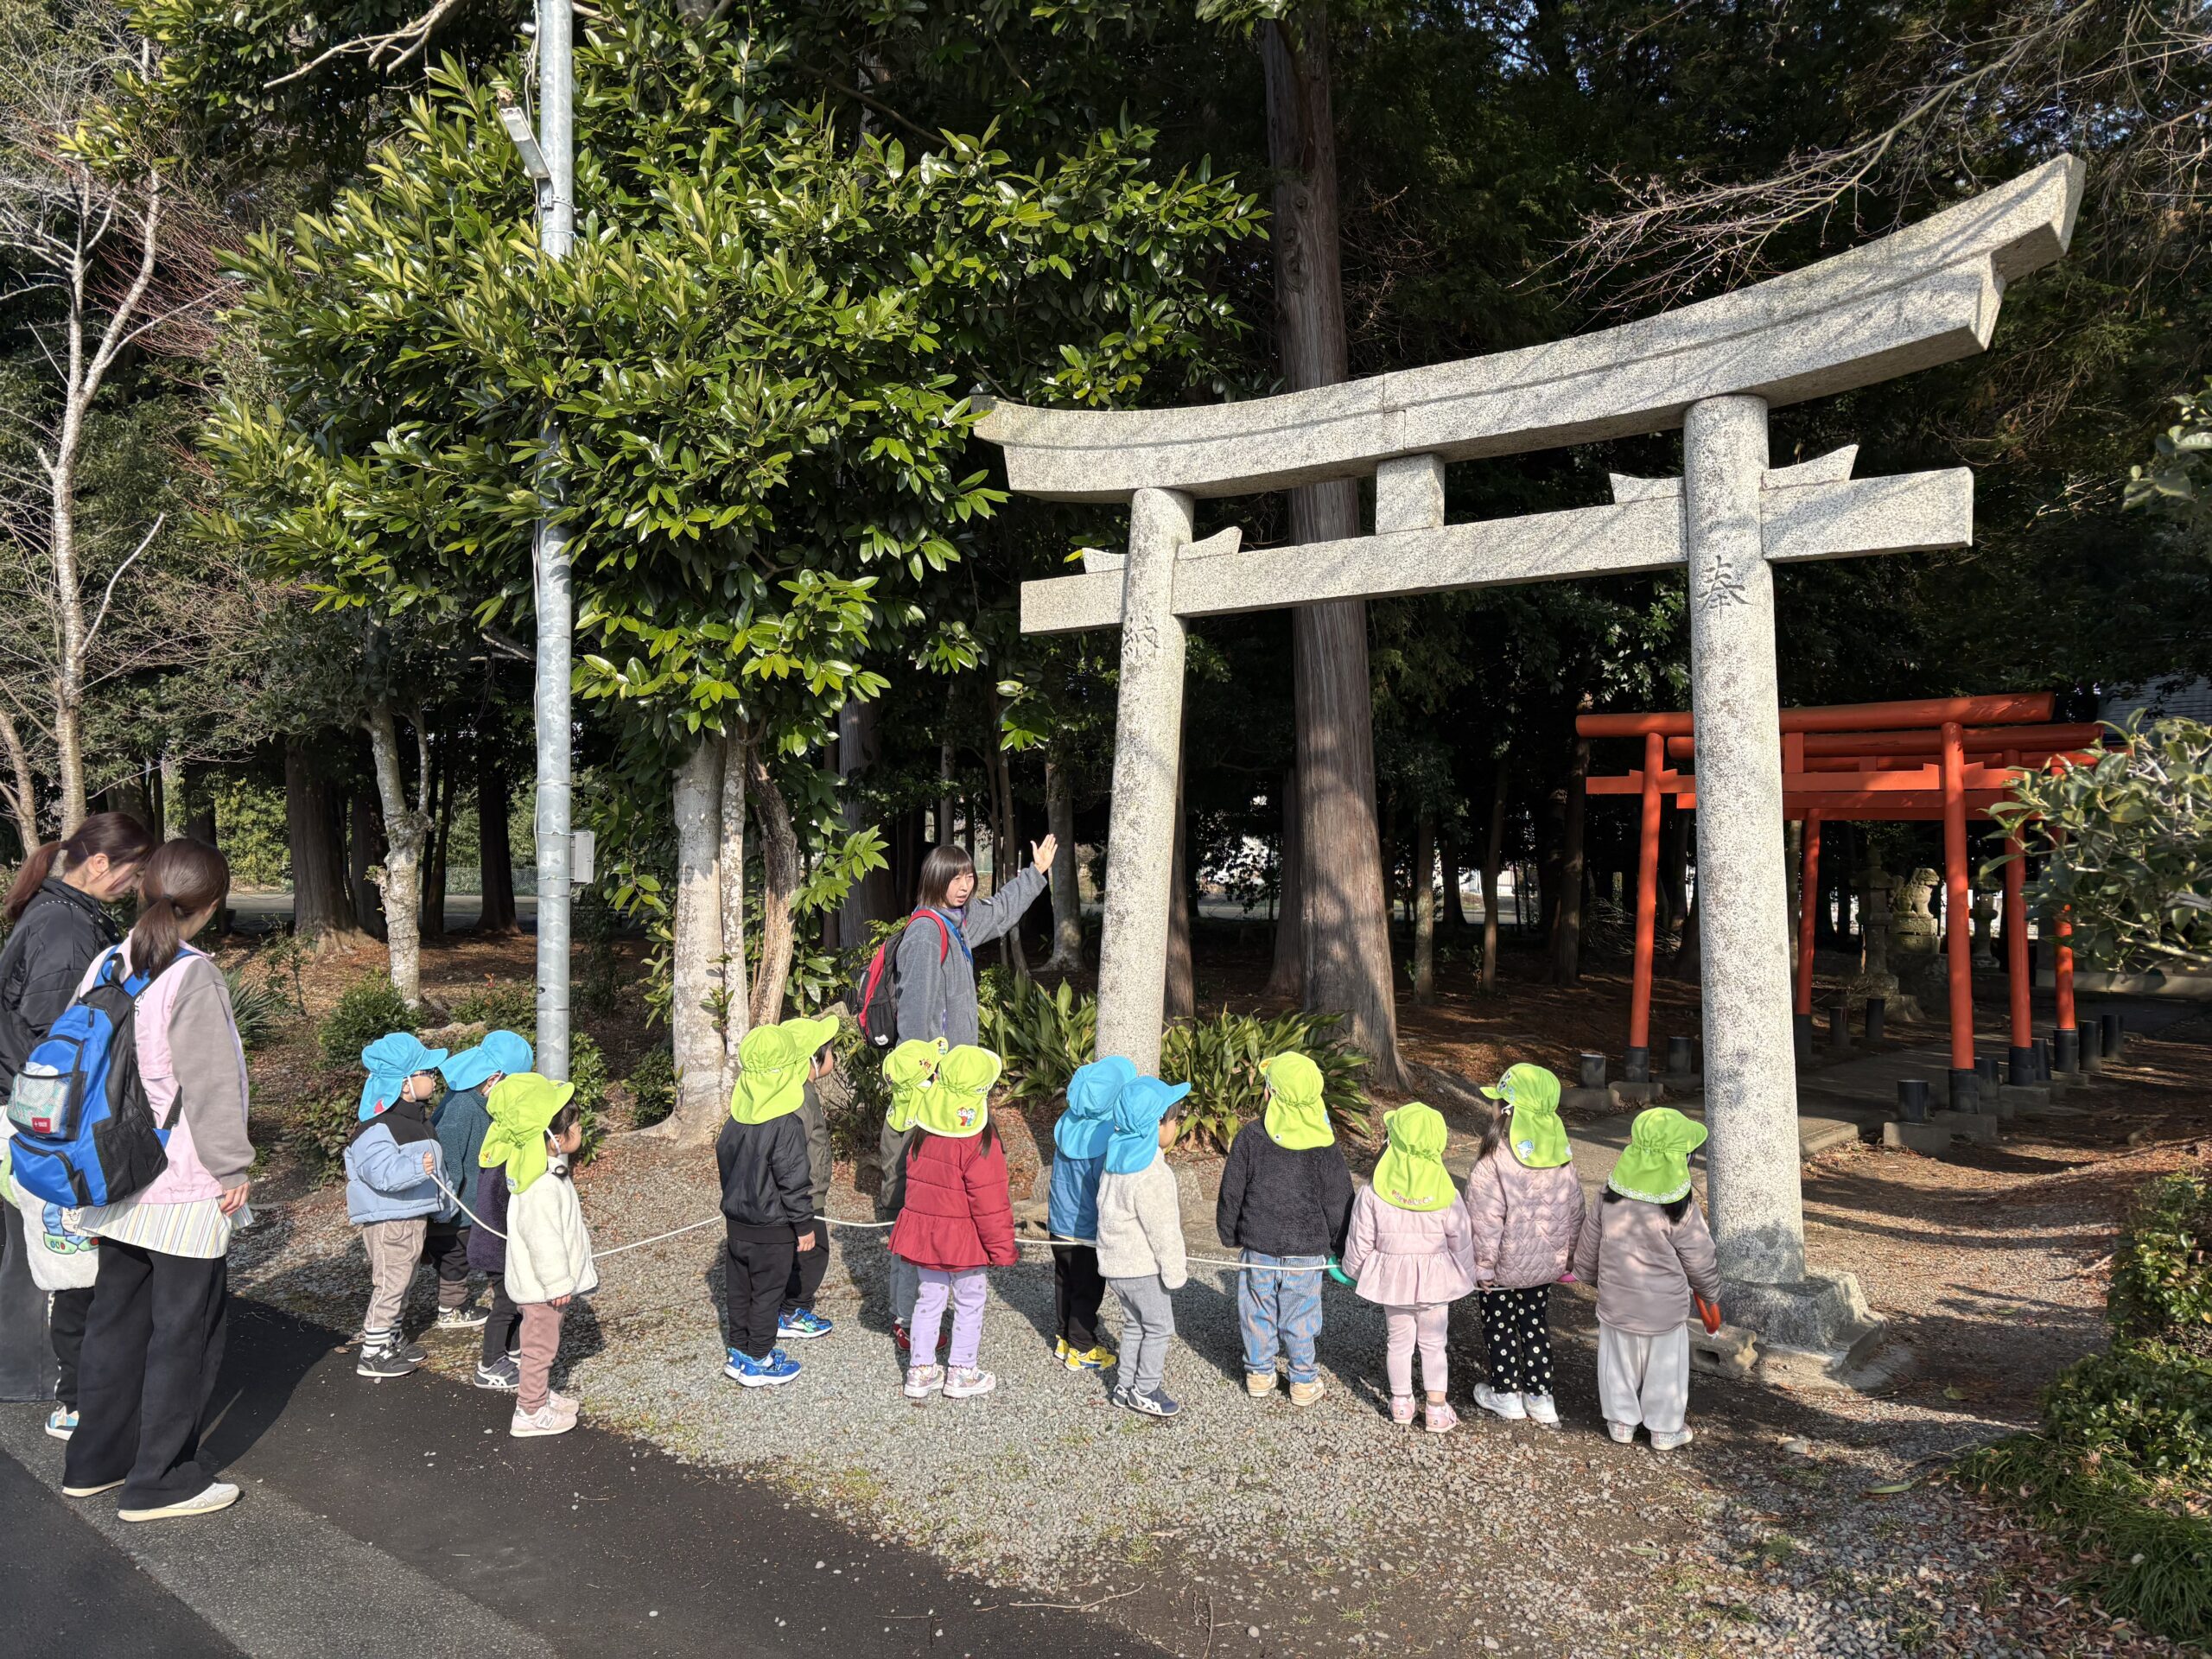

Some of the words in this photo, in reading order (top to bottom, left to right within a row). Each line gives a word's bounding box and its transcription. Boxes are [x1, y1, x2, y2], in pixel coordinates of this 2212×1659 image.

[1695, 553, 1753, 620] 奉
[378, 1349, 393, 1360] N
[539, 1414, 553, 1427] N
